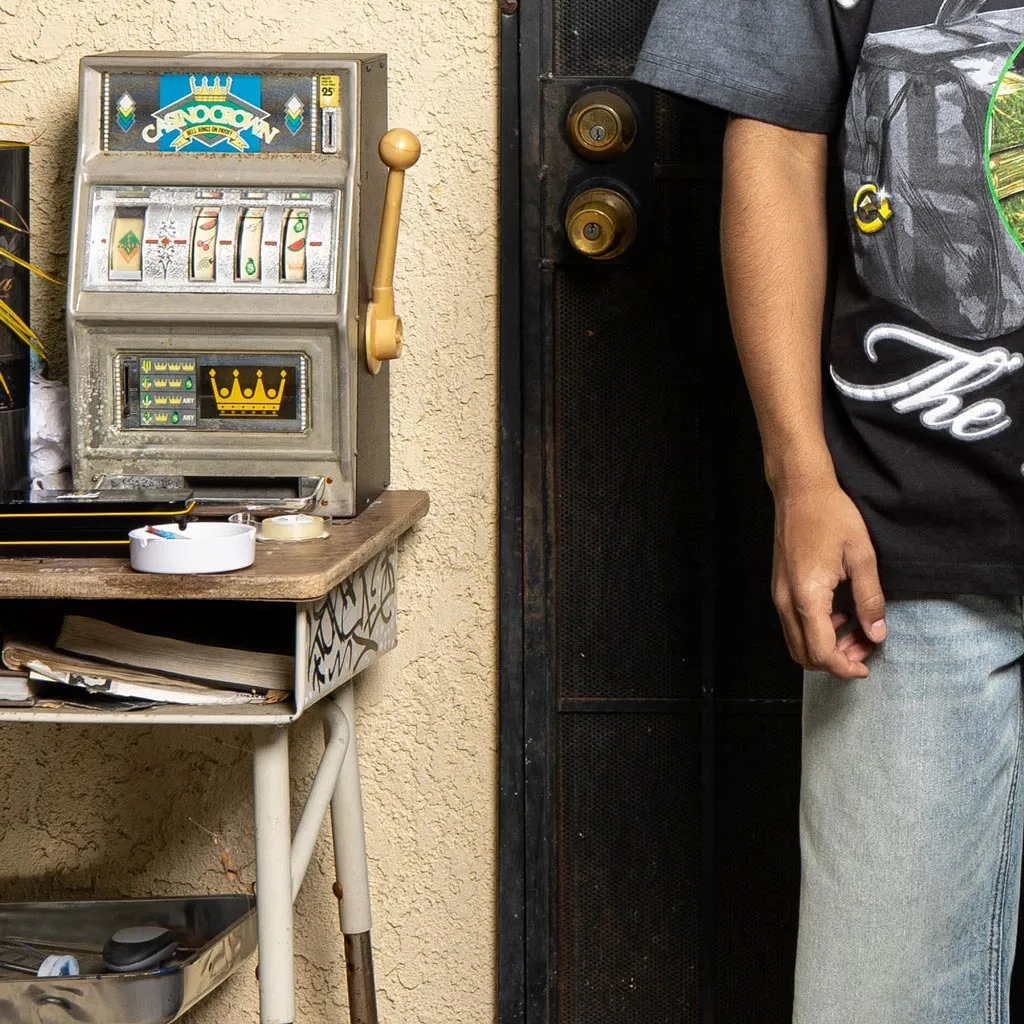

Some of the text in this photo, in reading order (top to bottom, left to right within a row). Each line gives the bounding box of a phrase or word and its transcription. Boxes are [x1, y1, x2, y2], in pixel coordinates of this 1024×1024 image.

[142, 105, 280, 144] CASINO CROWN
[830, 322, 1024, 440] The
[182, 397, 195, 405] ANY
[182, 414, 195, 422] ANY
